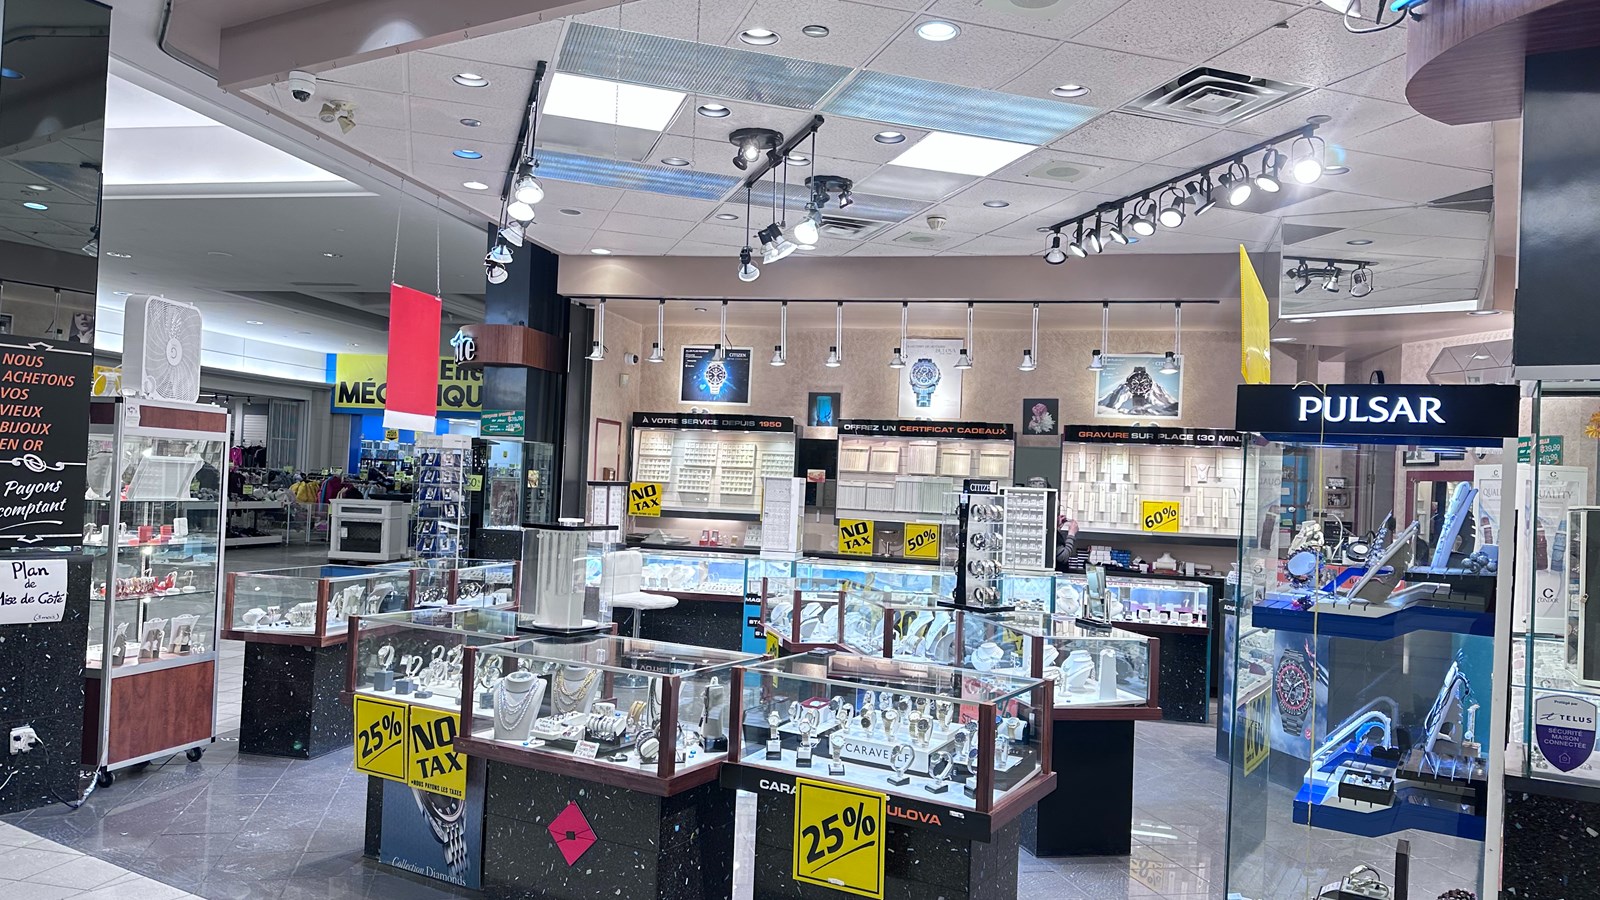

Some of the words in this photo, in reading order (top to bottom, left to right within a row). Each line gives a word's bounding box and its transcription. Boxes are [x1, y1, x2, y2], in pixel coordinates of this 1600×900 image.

[2, 353, 44, 368] NOUS
[2, 370, 75, 387] ACHETONS
[0, 387, 30, 400] VOS
[0, 404, 43, 418] VIEUX
[1298, 396, 1446, 424] PULSAR
[0, 421, 52, 435] BIJOUX
[651, 417, 678, 425] VOTRE
[681, 418, 719, 426] SERVICE
[721, 419, 756, 427] DEPUIS
[843, 423, 880, 431] OFFREZ
[899, 426, 954, 434] CERTIFICAT
[957, 427, 1007, 435] CADEAUX
[1078, 431, 1129, 439] GRAVURE
[1131, 432, 1154, 440] SUR
[0, 438, 19, 450] EN
[22, 439, 44, 451] OR
[3, 480, 63, 500] Payons
[631, 484, 657, 502] NO
[0, 498, 67, 520] comptant
[634, 497, 660, 512] TAX
[1145, 505, 1177, 529] 60%
[840, 521, 868, 540] NO
[844, 535, 871, 550] TAX
[907, 528, 936, 552] 50%
[11, 561, 50, 580] Plan
[24, 580, 37, 589] de
[20, 592, 35, 604] de
[37, 590, 66, 605] Côté
[1560, 714, 1592, 723] TELUS
[358, 710, 402, 760] 25%
[411, 715, 456, 754] NO
[1548, 728, 1583, 737] SÉCURITÉ
[1551, 733, 1579, 742] MAISON
[1543, 739, 1586, 748] CONNECTÉE
[418, 752, 463, 778] TAX
[885, 804, 942, 826] ULOVA
[802, 802, 876, 864] 25%
[391, 856, 425, 874] Collection
[425, 865, 467, 887] Diamonds
